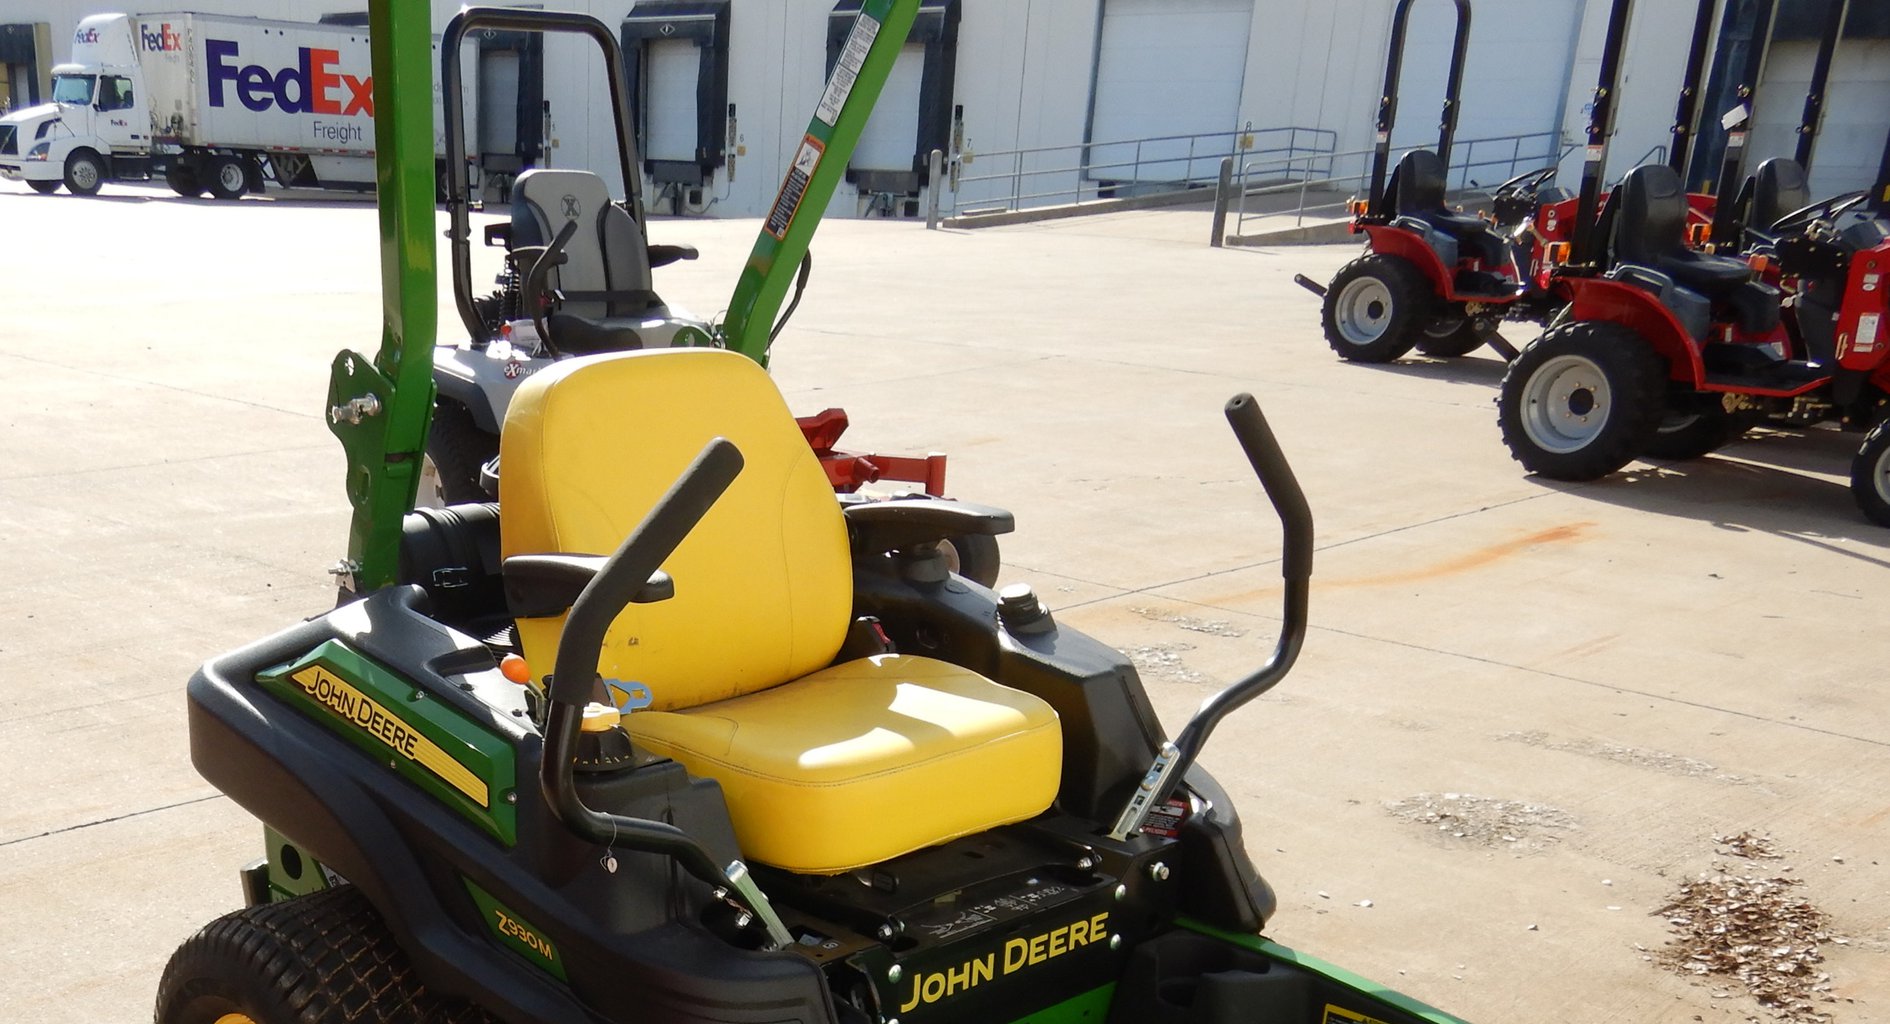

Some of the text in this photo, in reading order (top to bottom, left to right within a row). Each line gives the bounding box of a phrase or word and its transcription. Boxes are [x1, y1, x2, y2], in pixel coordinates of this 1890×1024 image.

[141, 24, 182, 51] FedEx
[205, 39, 374, 117] FedEx
[313, 120, 362, 145] Freight
[308, 671, 418, 757] JOHN DEERE
[496, 910, 553, 960] Z930M
[900, 911, 1109, 1014] JOHN DEERE
